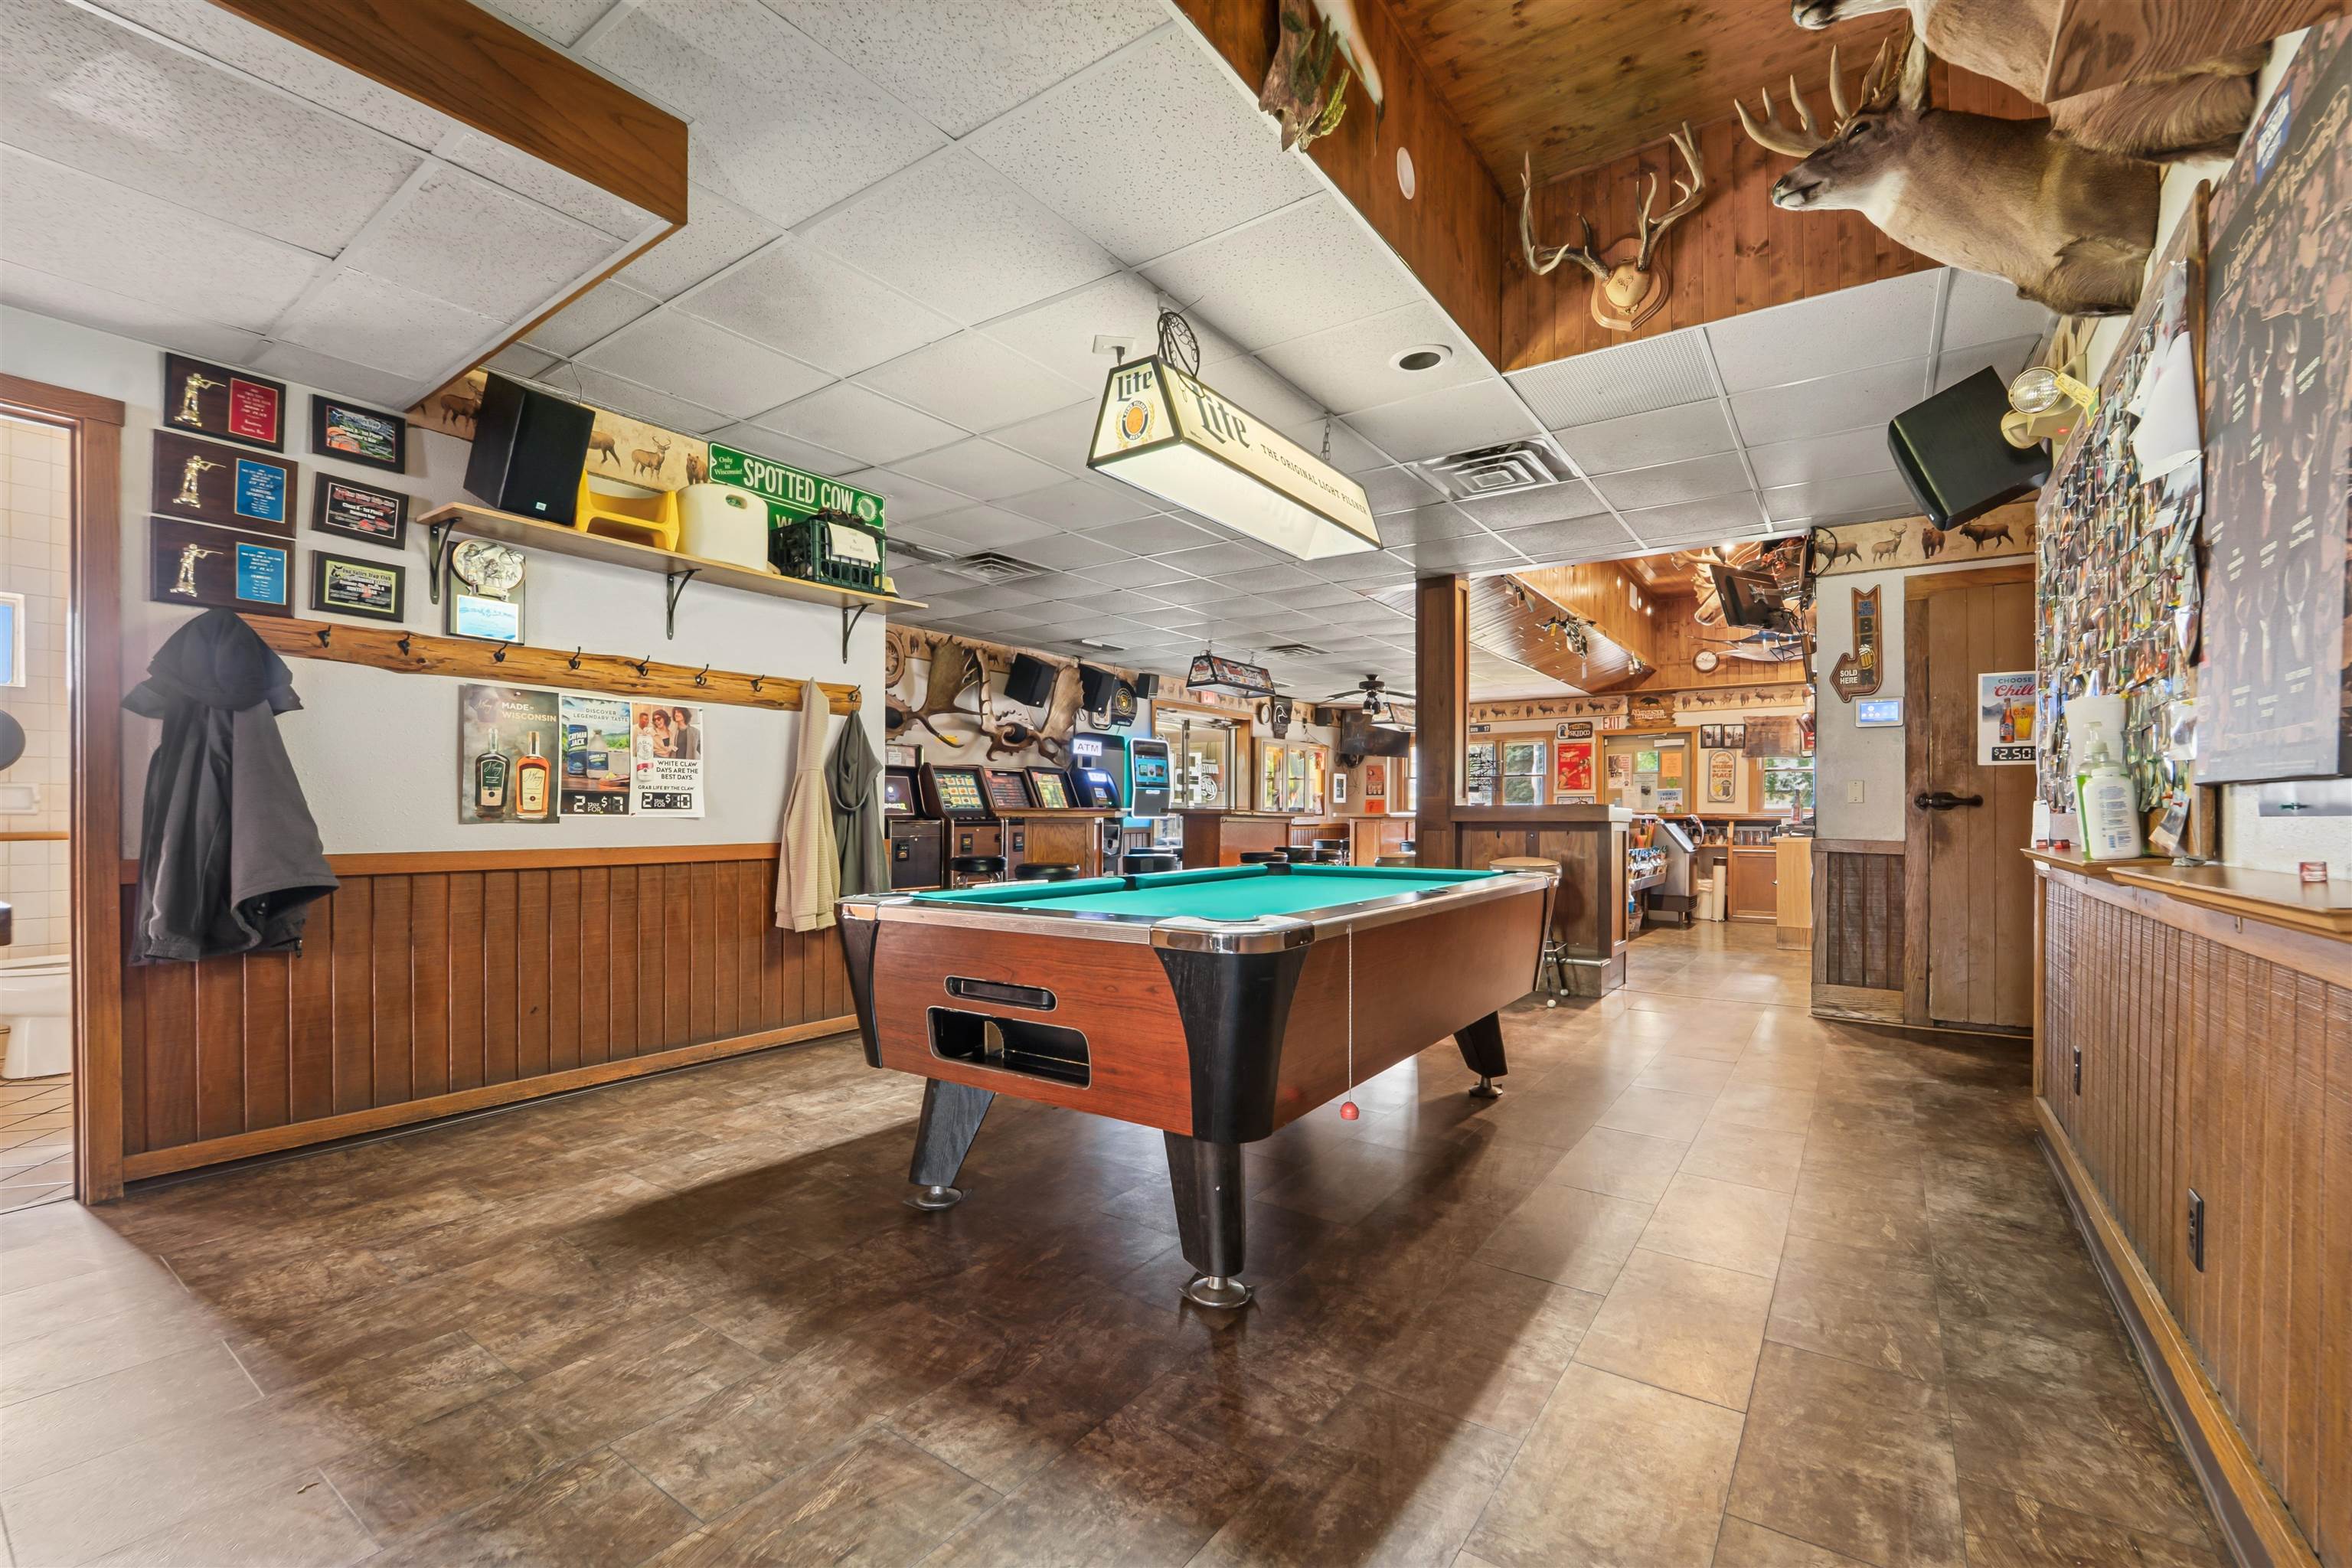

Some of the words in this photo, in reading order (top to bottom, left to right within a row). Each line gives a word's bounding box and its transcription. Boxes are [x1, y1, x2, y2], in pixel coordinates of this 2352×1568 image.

[1116, 371, 1153, 401] Lite
[1191, 383, 1250, 448] Lite
[1260, 443, 1279, 461] THE
[1280, 456, 1318, 485] ORIGINAL
[1318, 479, 1341, 498] LIGHT
[1341, 493, 1367, 515] PILSNER
[743, 458, 815, 504] SPOTTED
[821, 482, 854, 514] COW
[1994, 684, 2036, 697] Chill
[502, 702, 529, 710] MADE
[502, 711, 557, 722] WISCONSIN
[1602, 717, 1621, 729] EXIT
[1077, 743, 1099, 752] ATM
[1994, 748, 2031, 760] $2.50
[574, 795, 586, 812] 2
[643, 793, 652, 807] 2
